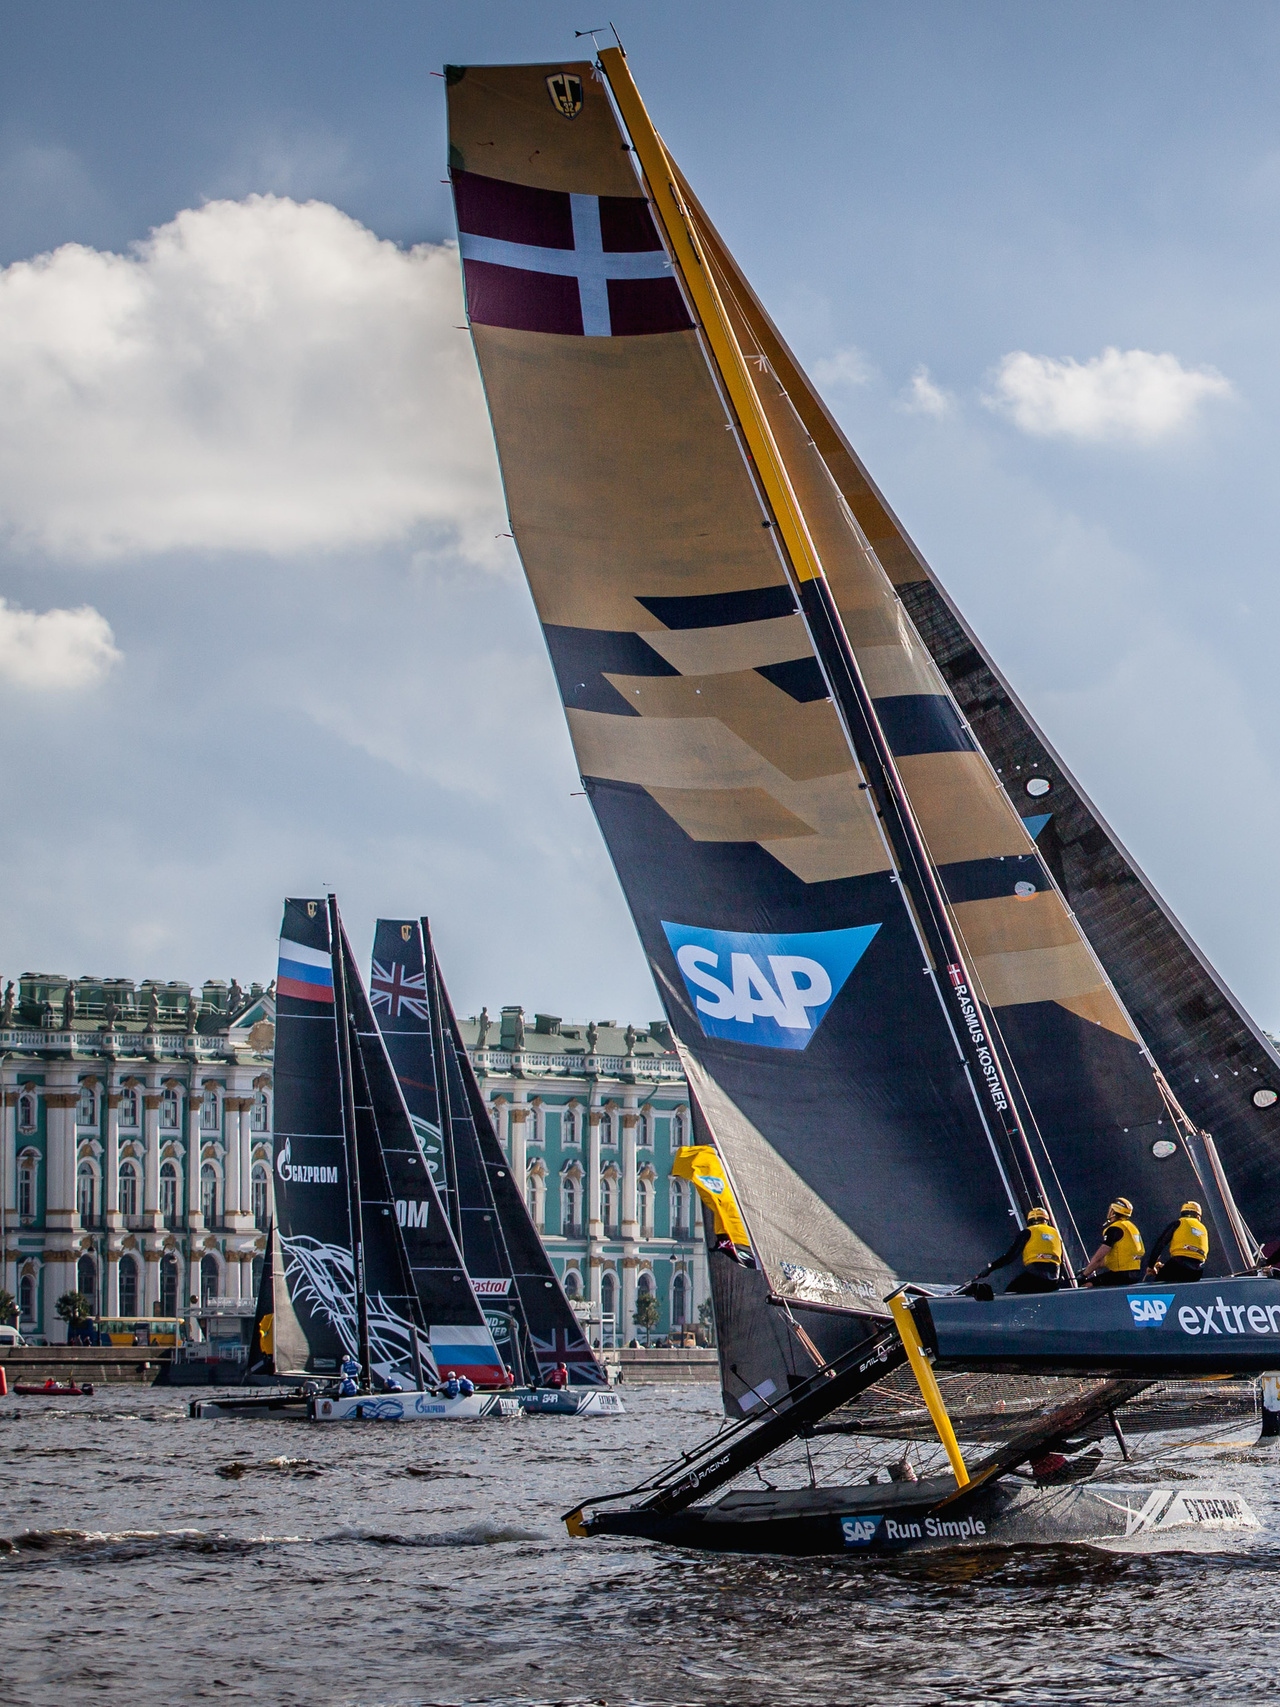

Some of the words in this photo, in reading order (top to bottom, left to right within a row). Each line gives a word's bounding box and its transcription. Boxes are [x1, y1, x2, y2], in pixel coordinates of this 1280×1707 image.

[677, 944, 832, 1030] SAP
[955, 984, 984, 1044] RASMUS
[976, 1046, 1008, 1112] KOSTNER
[292, 1165, 338, 1184] GAZPROM
[1130, 1300, 1168, 1322] SAP
[842, 1521, 876, 1542] SAP
[885, 1519, 922, 1539] Run
[924, 1516, 987, 1540] Simple
